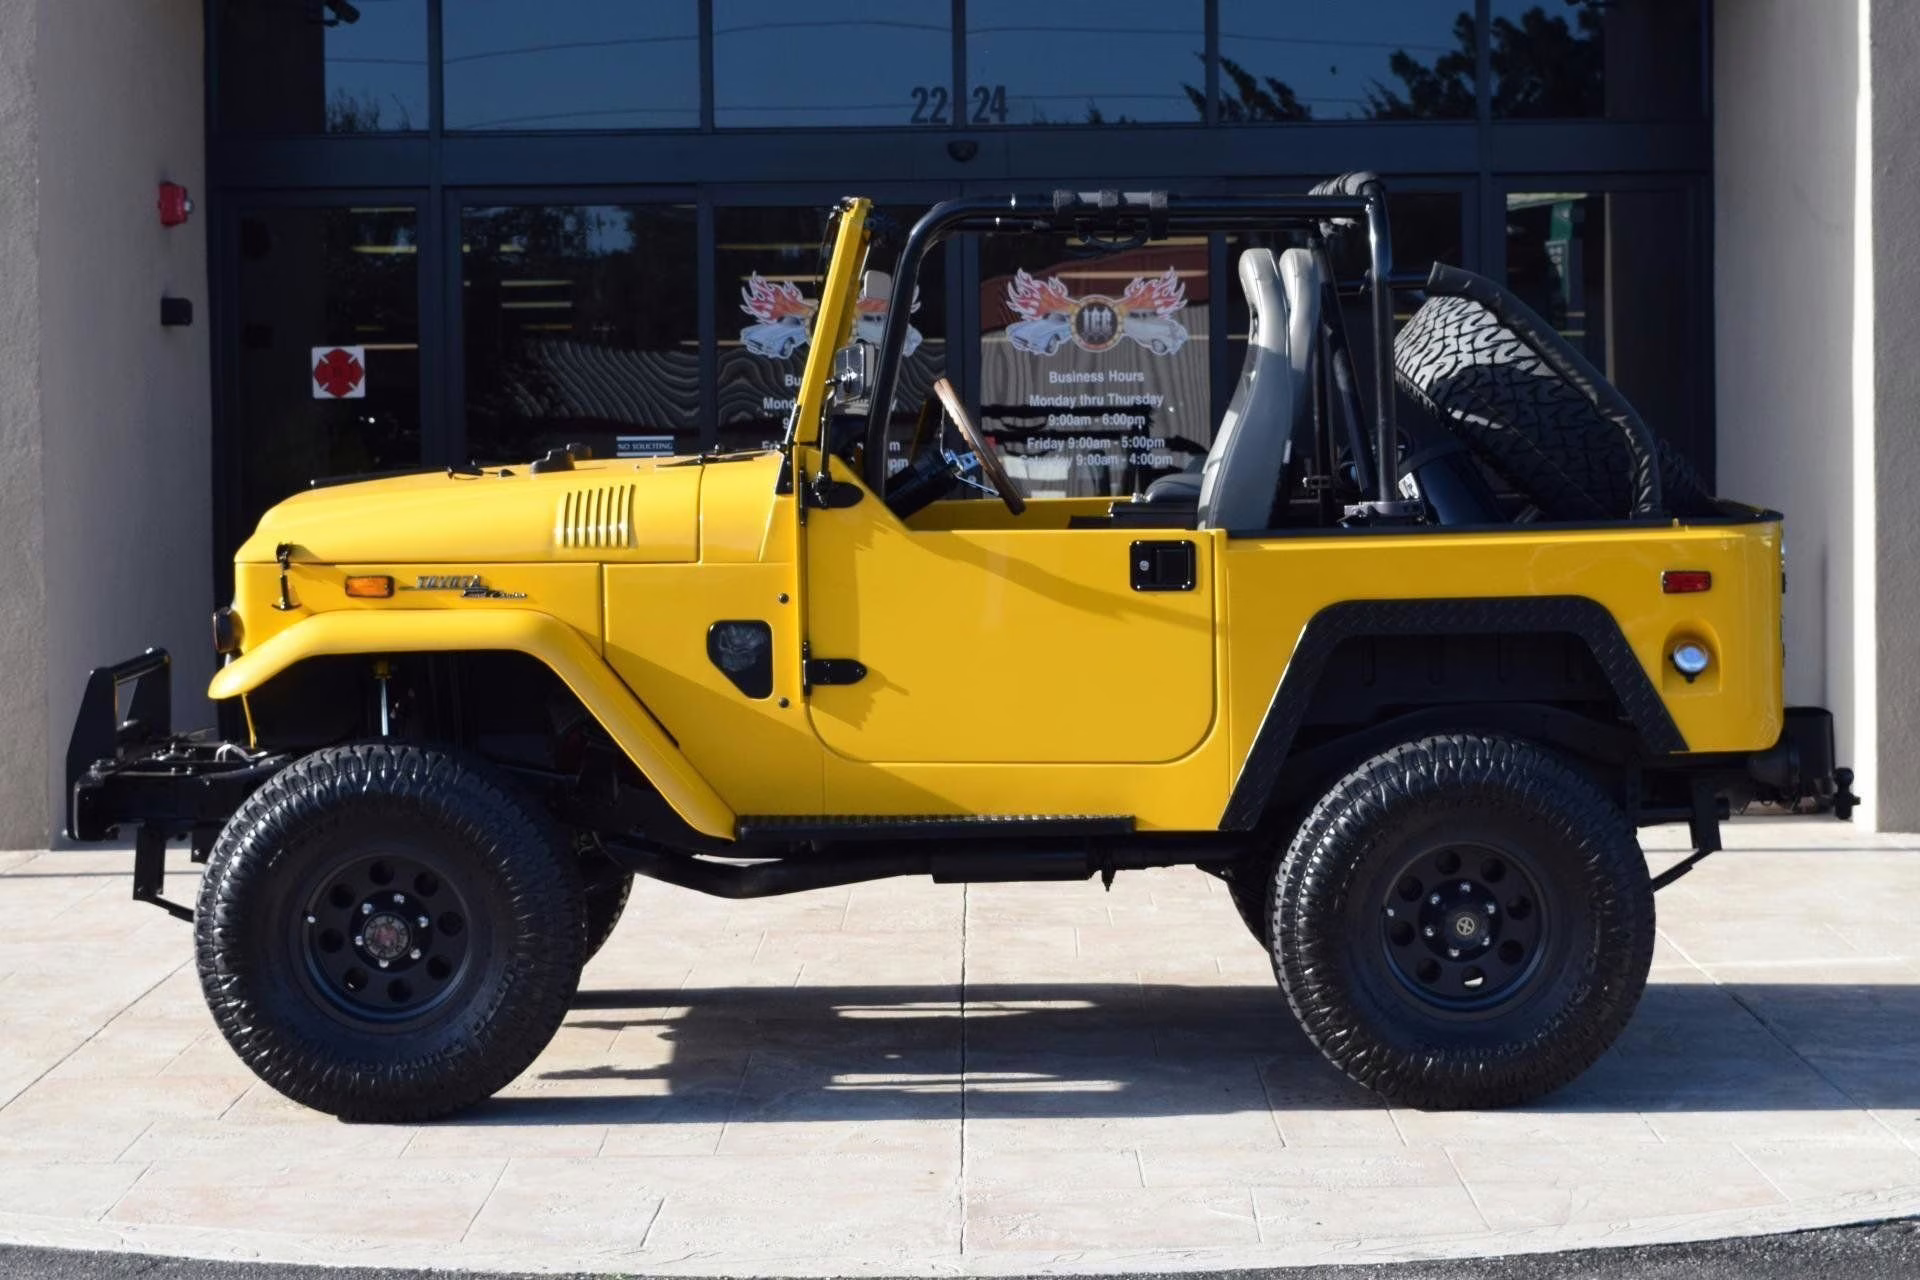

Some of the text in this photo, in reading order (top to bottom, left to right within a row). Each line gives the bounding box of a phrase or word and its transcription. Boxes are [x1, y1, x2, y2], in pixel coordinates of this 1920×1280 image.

[910, 85, 1009, 124] 22 24
[1049, 370, 1145, 384] Business Hours
[1029, 393, 1164, 409] Monday thru Thursday
[1048, 413, 1092, 426] 9:00am
[1101, 413, 1146, 429] 6:00pm
[1026, 437, 1065, 451] Friday
[1067, 437, 1111, 449] 9:00am
[1121, 436, 1165, 451] 5:00pm
[1075, 454, 1119, 466] 9:00am
[1128, 453, 1174, 468] 4:00pm
[416, 575, 481, 589] TOYOTA
